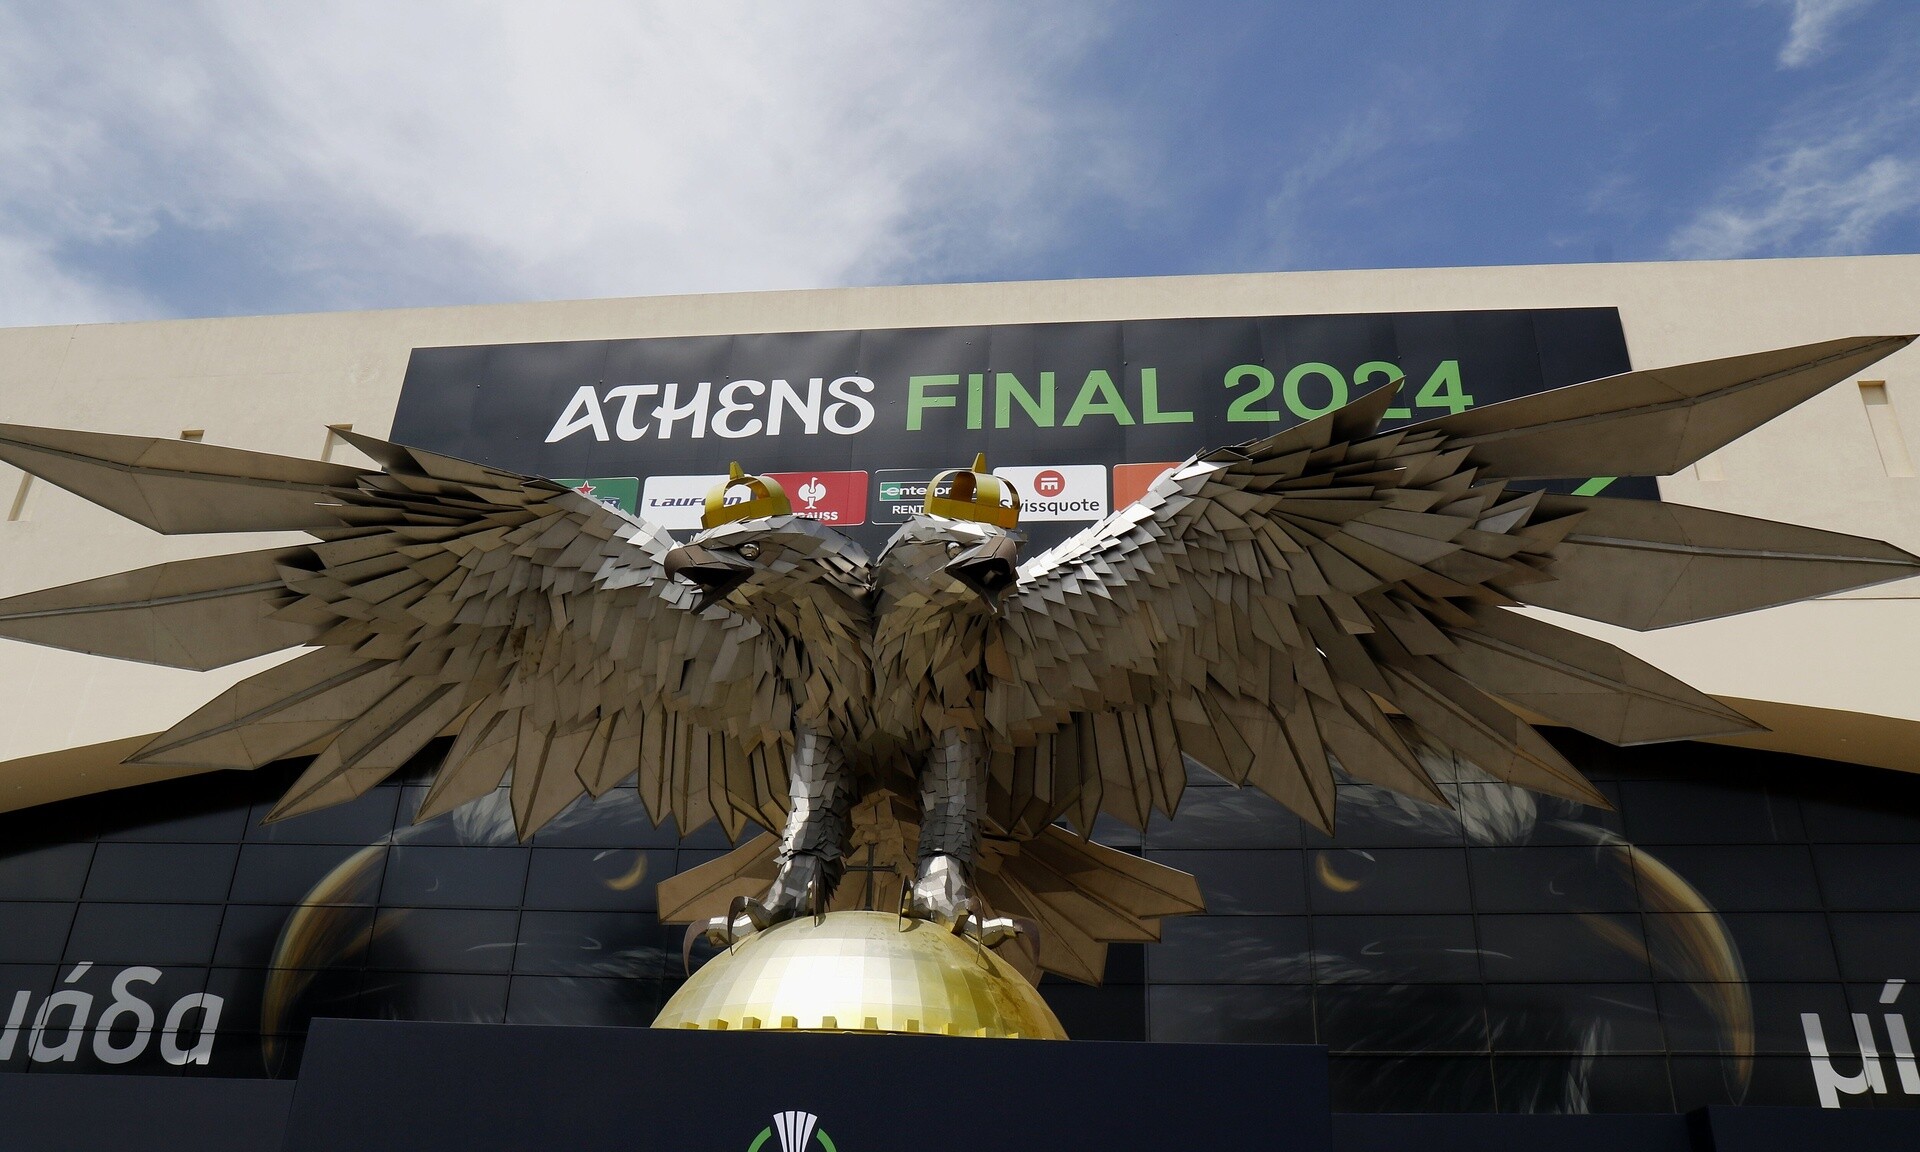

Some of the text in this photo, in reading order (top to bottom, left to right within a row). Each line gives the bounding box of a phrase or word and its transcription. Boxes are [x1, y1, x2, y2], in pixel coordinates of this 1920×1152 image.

[545, 360, 1474, 443] ATHENS FINAL 2024
